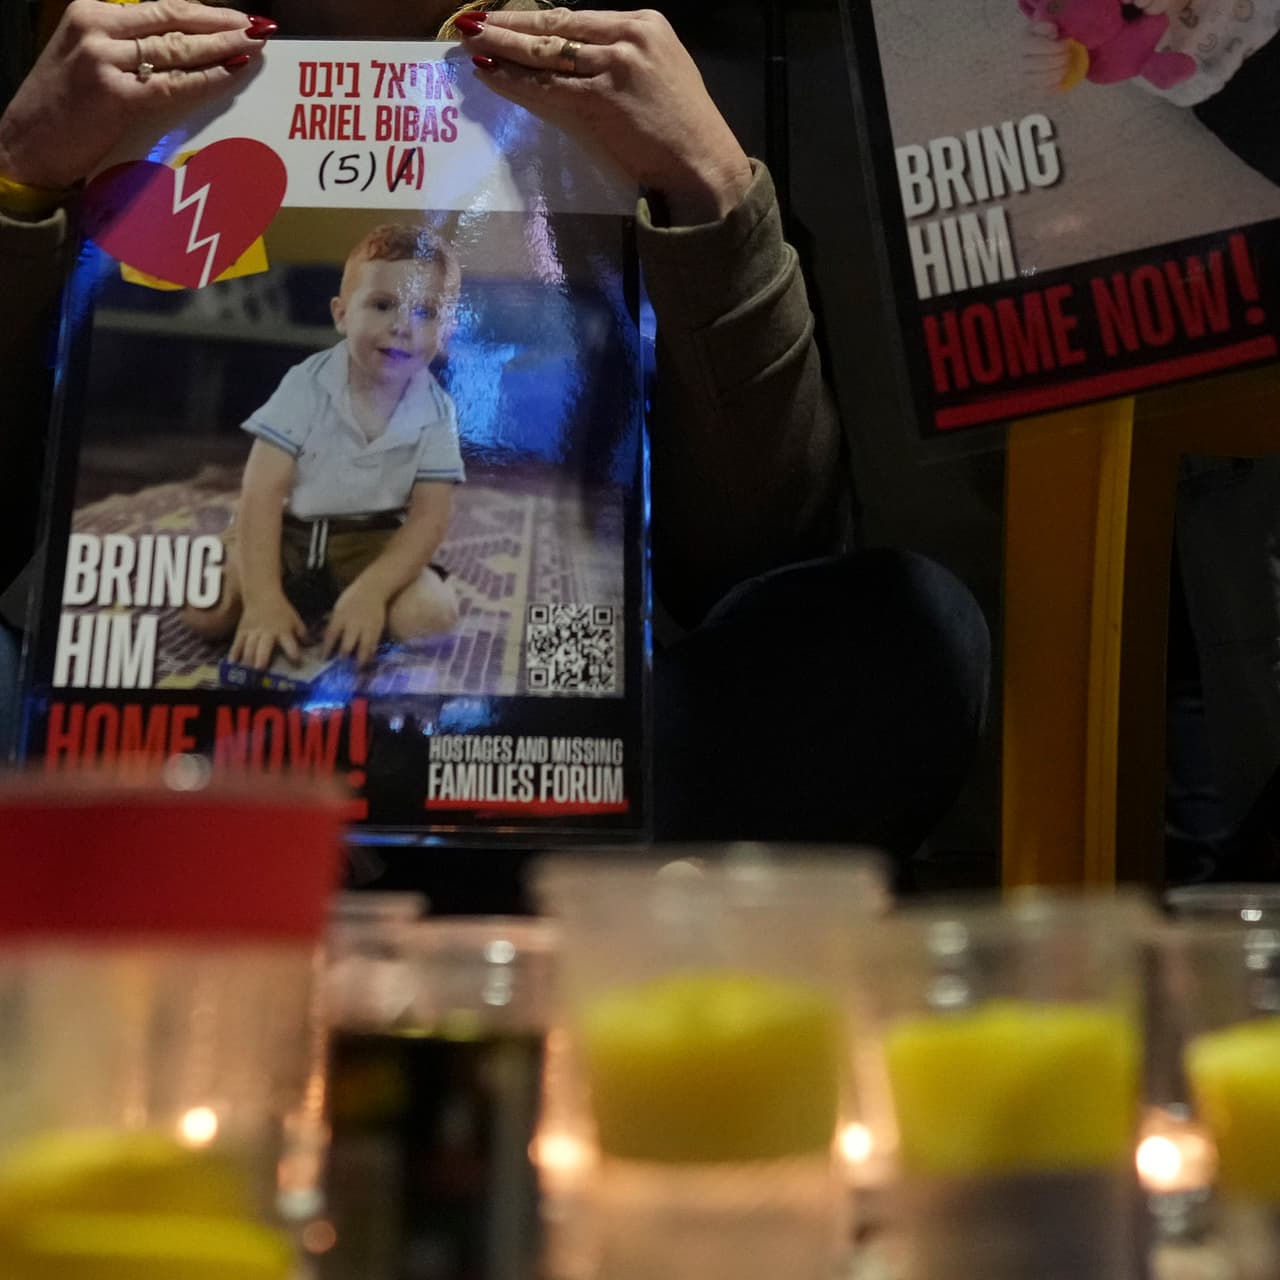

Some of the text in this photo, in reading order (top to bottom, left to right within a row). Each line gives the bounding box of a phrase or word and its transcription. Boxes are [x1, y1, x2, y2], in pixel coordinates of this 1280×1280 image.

[298, 60, 457, 100] אריאל ביבס
[289, 104, 459, 143] ARIEL BIBAS
[319, 150, 377, 192] (5)
[895, 113, 1062, 218] BRING
[906, 204, 1017, 300] HIM
[923, 232, 1266, 394] HOME NOW!
[62, 533, 223, 609] BRING
[52, 614, 160, 688] HIM
[45, 698, 368, 788] HOME NOW!
[429, 736, 624, 763] HOSTAGES AND MISSING
[427, 763, 624, 804] FAMILIES FORUM
